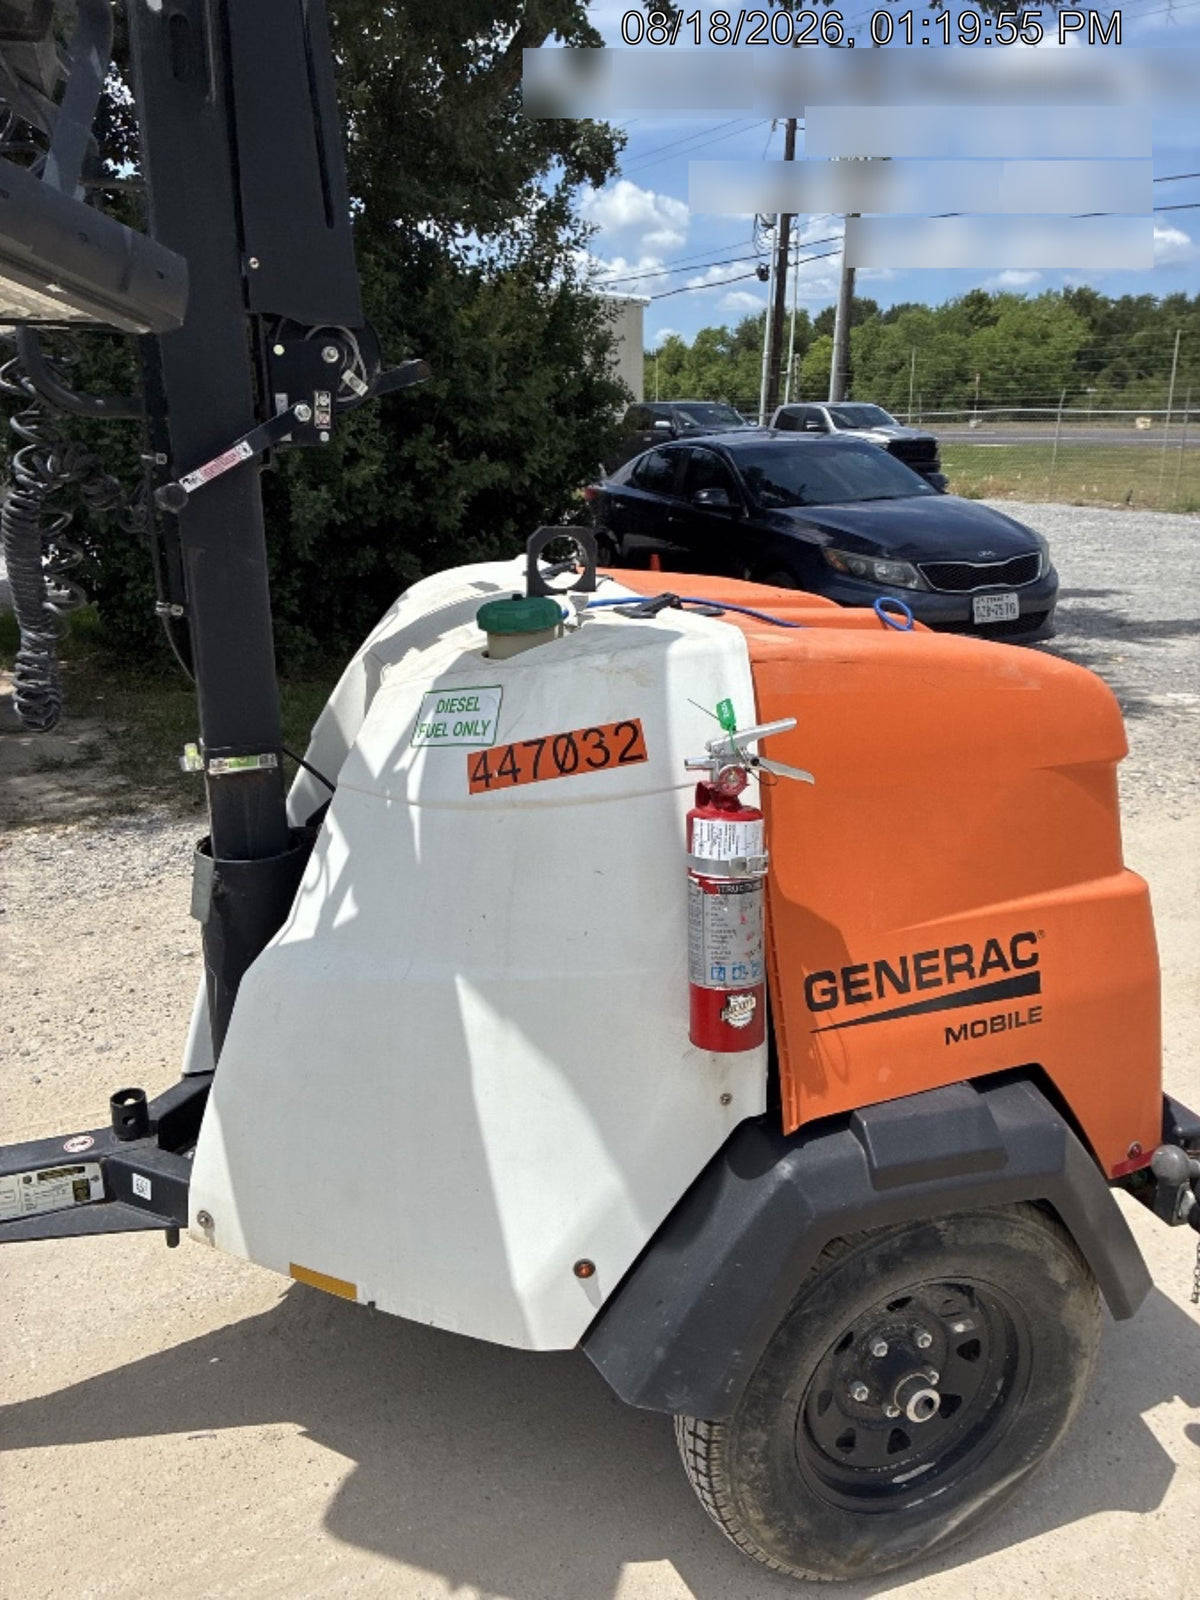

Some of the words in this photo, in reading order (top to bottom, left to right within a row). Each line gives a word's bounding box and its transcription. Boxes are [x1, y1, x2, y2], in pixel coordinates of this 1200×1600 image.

[436, 697, 481, 714] DIESEL
[418, 722, 451, 738] FUEL
[453, 720, 491, 737] ONLY
[471, 721, 644, 788] 447032
[804, 931, 1039, 1012] GENERAC
[944, 1006, 1043, 1045] MOBILE
